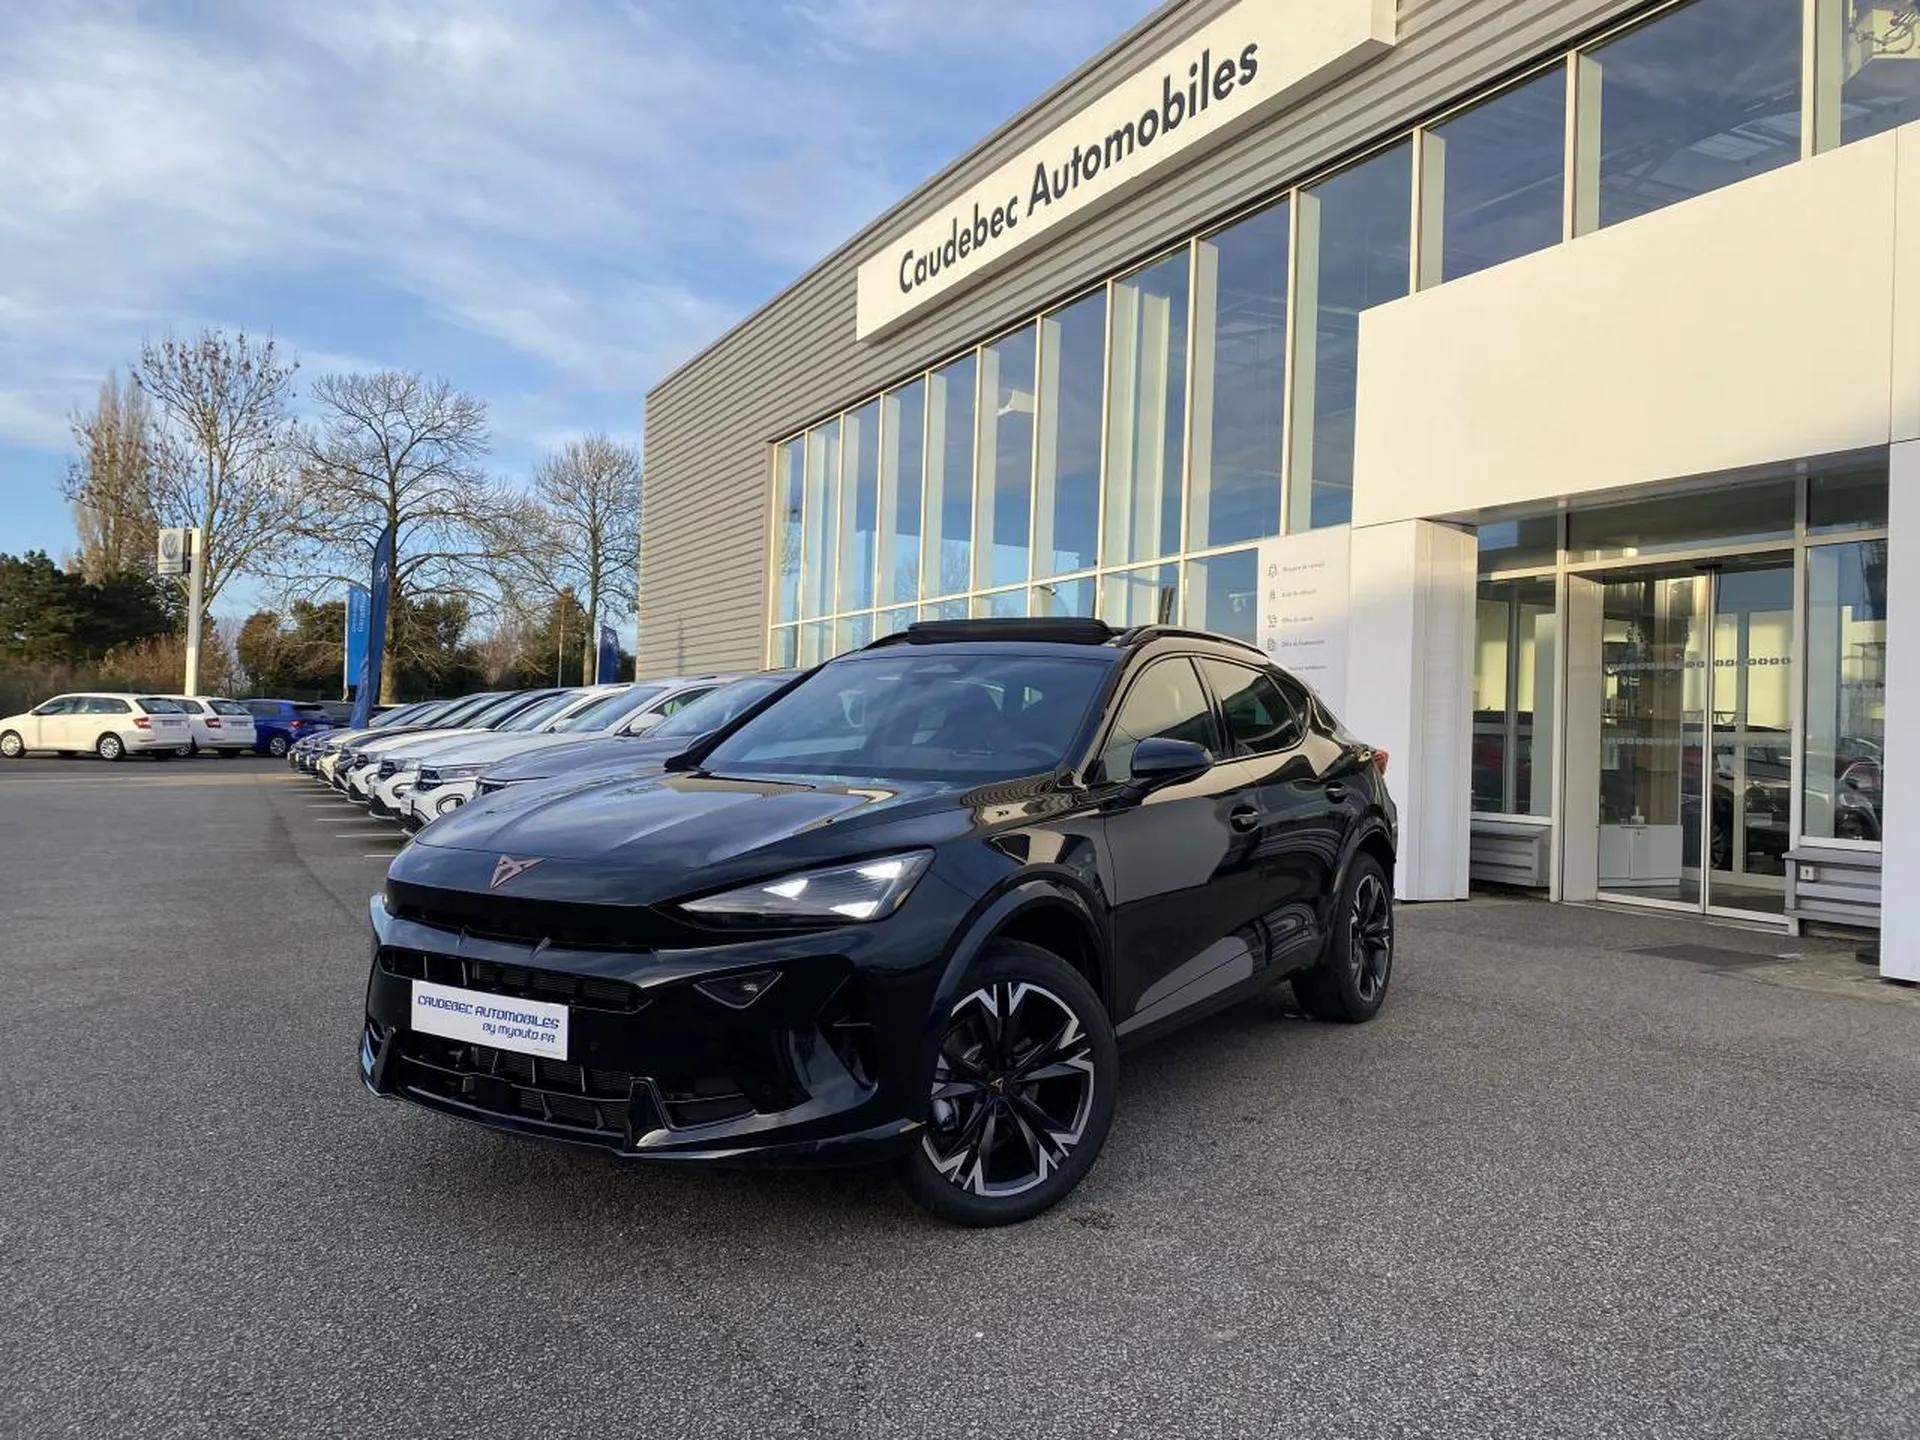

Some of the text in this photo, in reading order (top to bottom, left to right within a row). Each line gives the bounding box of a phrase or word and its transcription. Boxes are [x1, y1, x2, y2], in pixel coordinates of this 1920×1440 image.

[899, 42, 1258, 293] Caudebec Automobiles
[418, 995, 560, 1029] CAUDEBEC AUTOMOBILES
